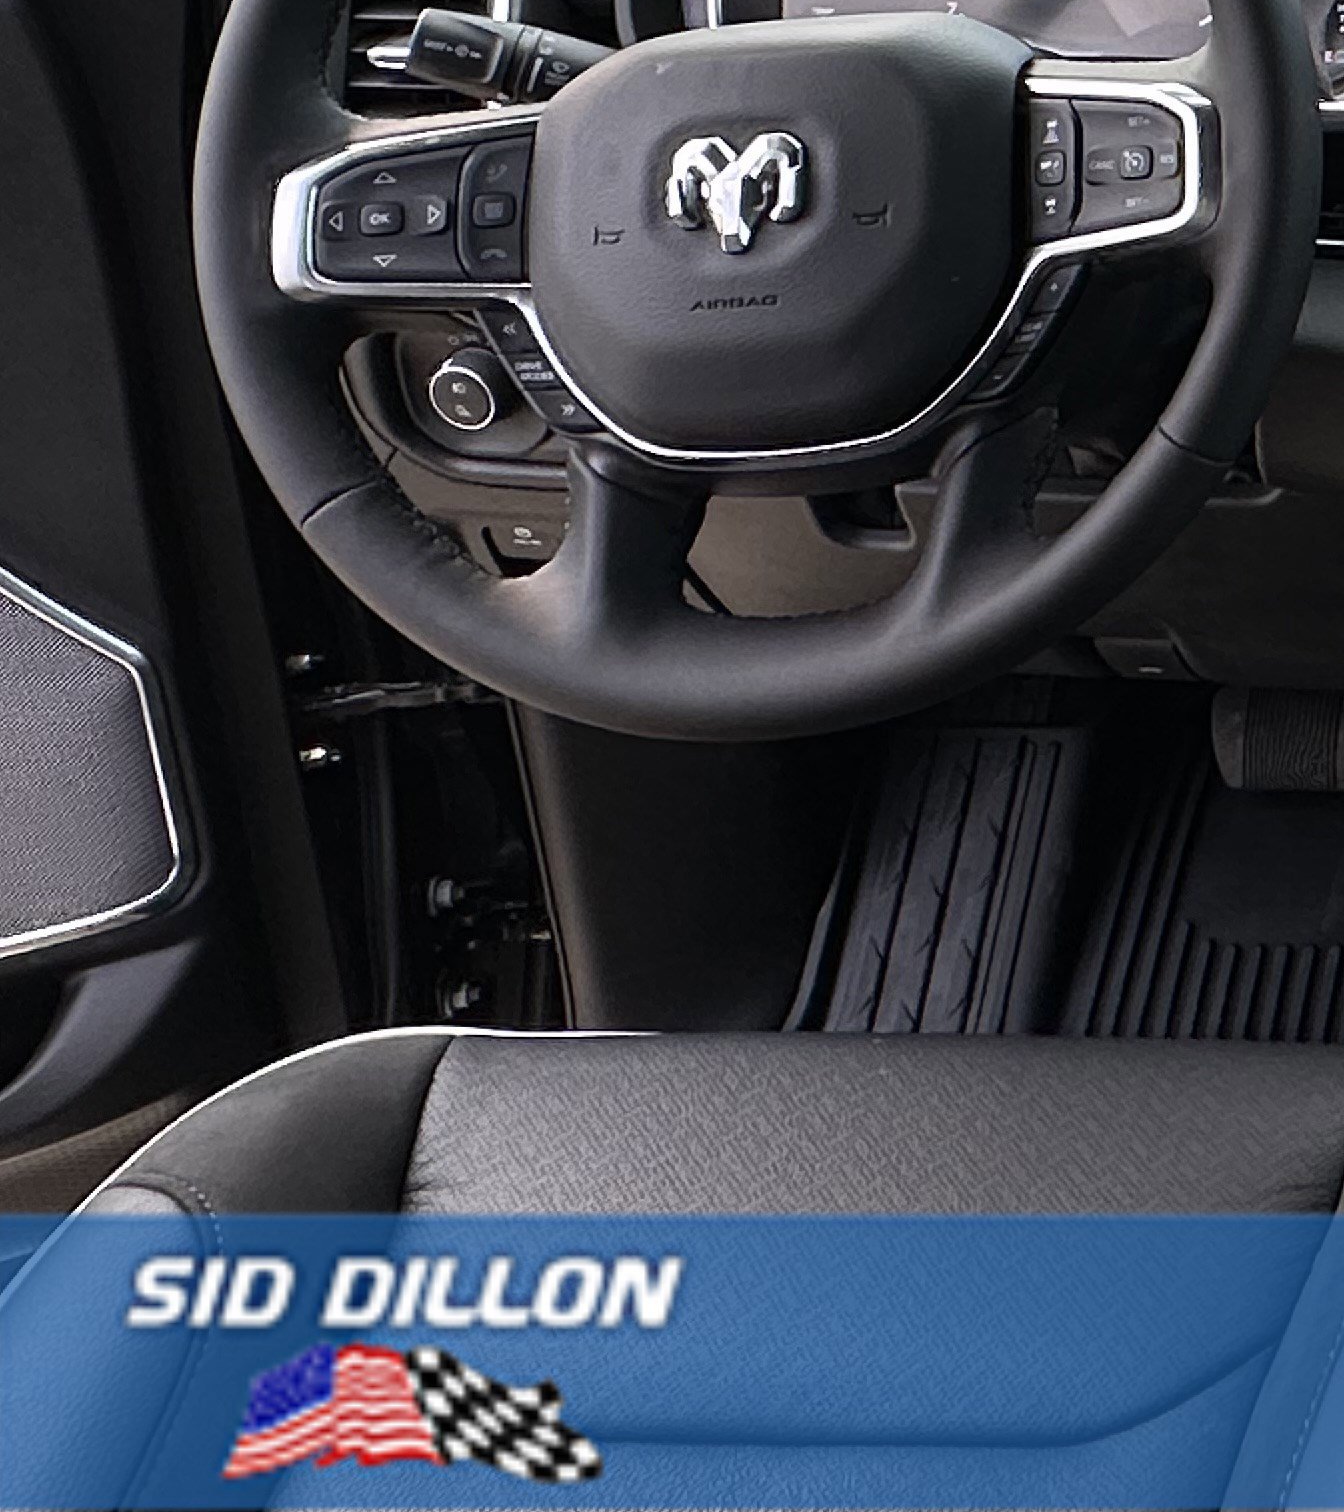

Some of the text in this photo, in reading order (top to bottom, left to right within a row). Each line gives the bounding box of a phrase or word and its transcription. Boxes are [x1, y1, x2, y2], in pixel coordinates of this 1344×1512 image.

[946, 1, 958, 14] 7
[368, 212, 392, 227] OK
[688, 294, 779, 312] AIRBAG
